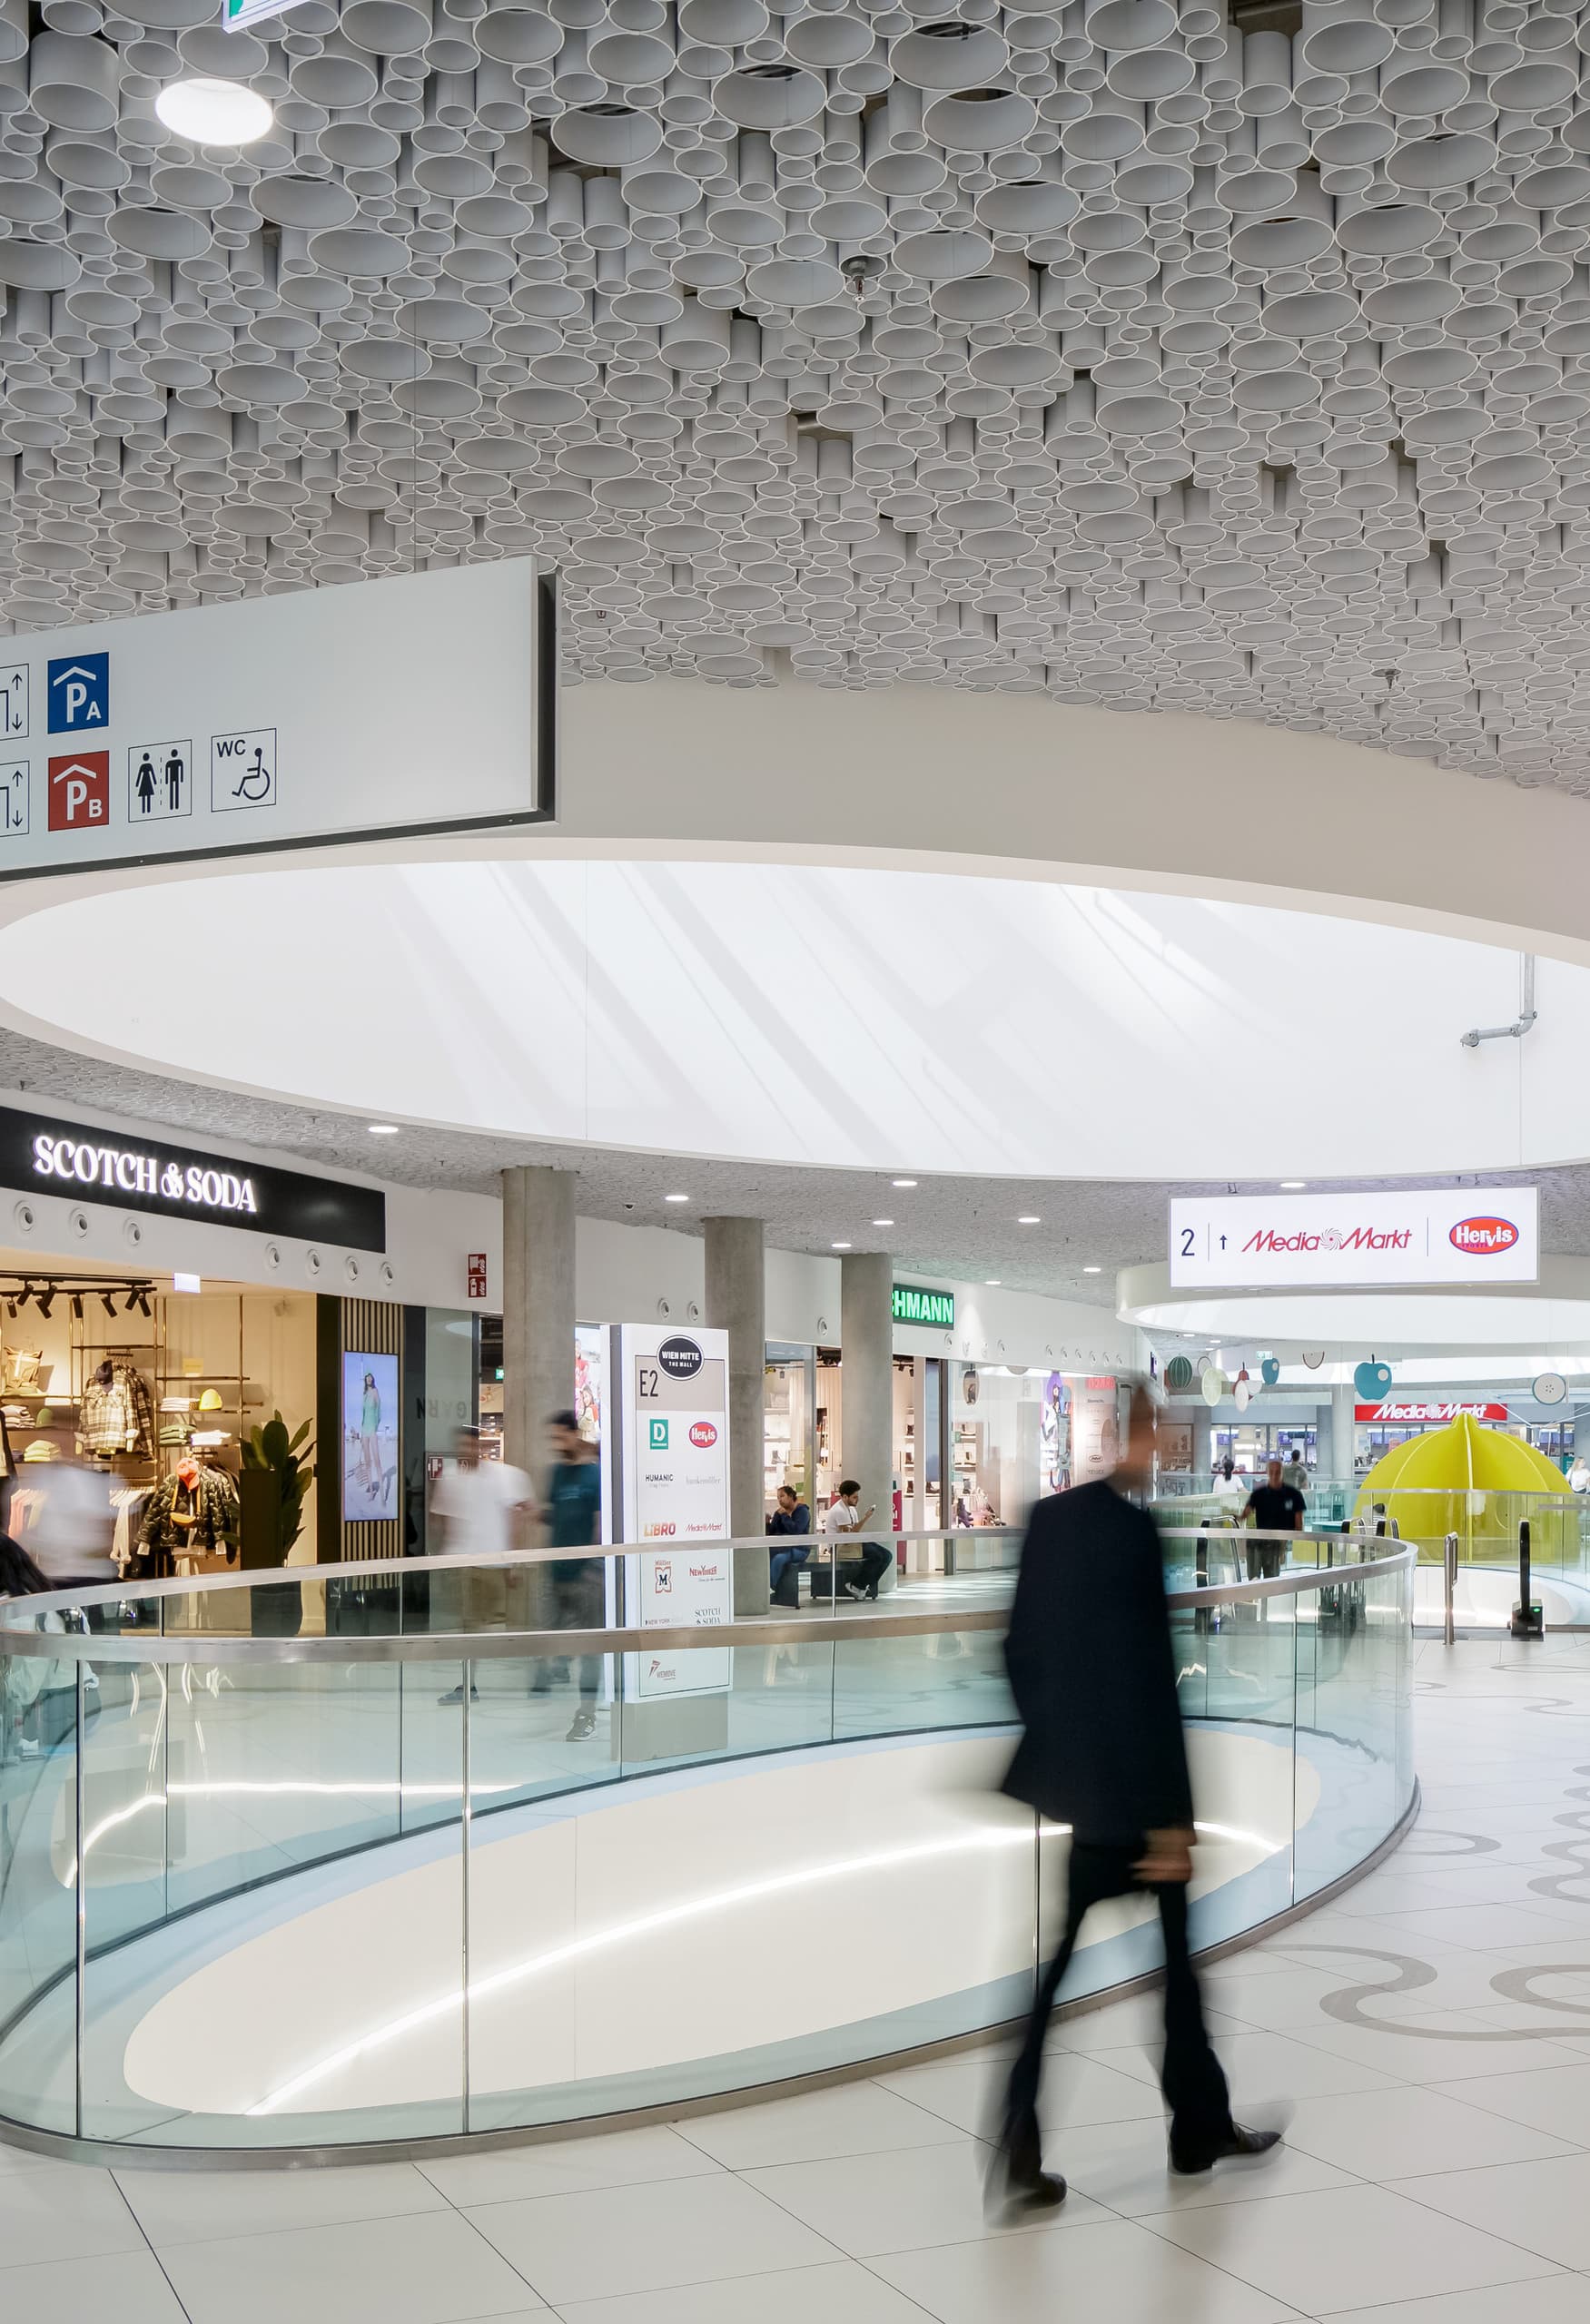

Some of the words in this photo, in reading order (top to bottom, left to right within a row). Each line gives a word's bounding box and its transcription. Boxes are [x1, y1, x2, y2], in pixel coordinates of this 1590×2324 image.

[216, 739, 246, 758] WC
[33, 1135, 157, 1194] SCOTCH
[161, 1162, 184, 1199] &
[185, 1167, 257, 1213] SODA
[1180, 1228, 1195, 1256] 2
[1456, 1226, 1513, 1247] Hervis
[662, 1351, 679, 1360] WIEN
[680, 1352, 700, 1361] MITTE
[639, 1369, 659, 1397] E2
[653, 1423, 667, 1442] D
[691, 1427, 716, 1443] Hervis
[645, 1473, 674, 1482] HUMANIC
